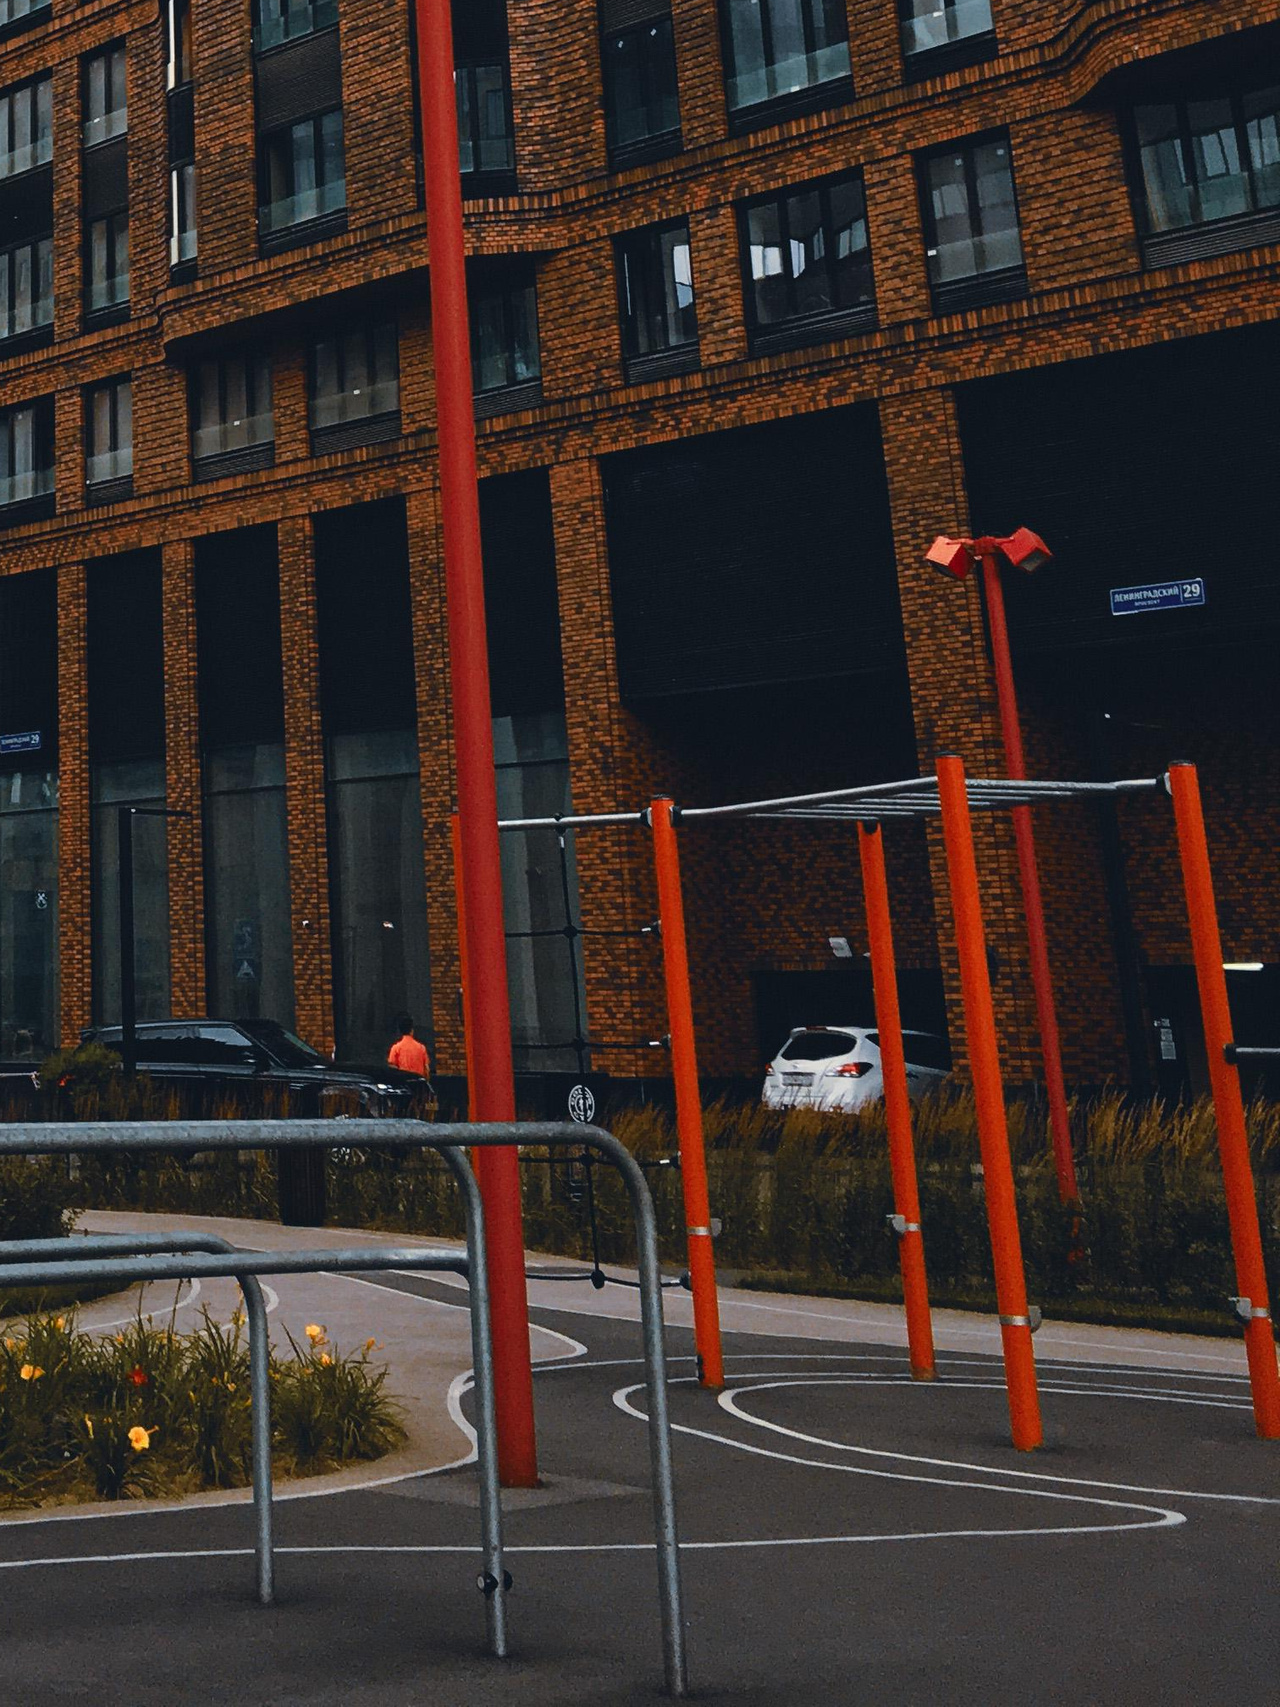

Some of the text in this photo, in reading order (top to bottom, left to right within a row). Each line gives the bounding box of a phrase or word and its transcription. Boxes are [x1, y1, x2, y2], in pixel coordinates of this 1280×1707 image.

[1114, 583, 1200, 602] ЛЕНИНГРАДСКИЙ 29
[31, 734, 40, 744] 29
